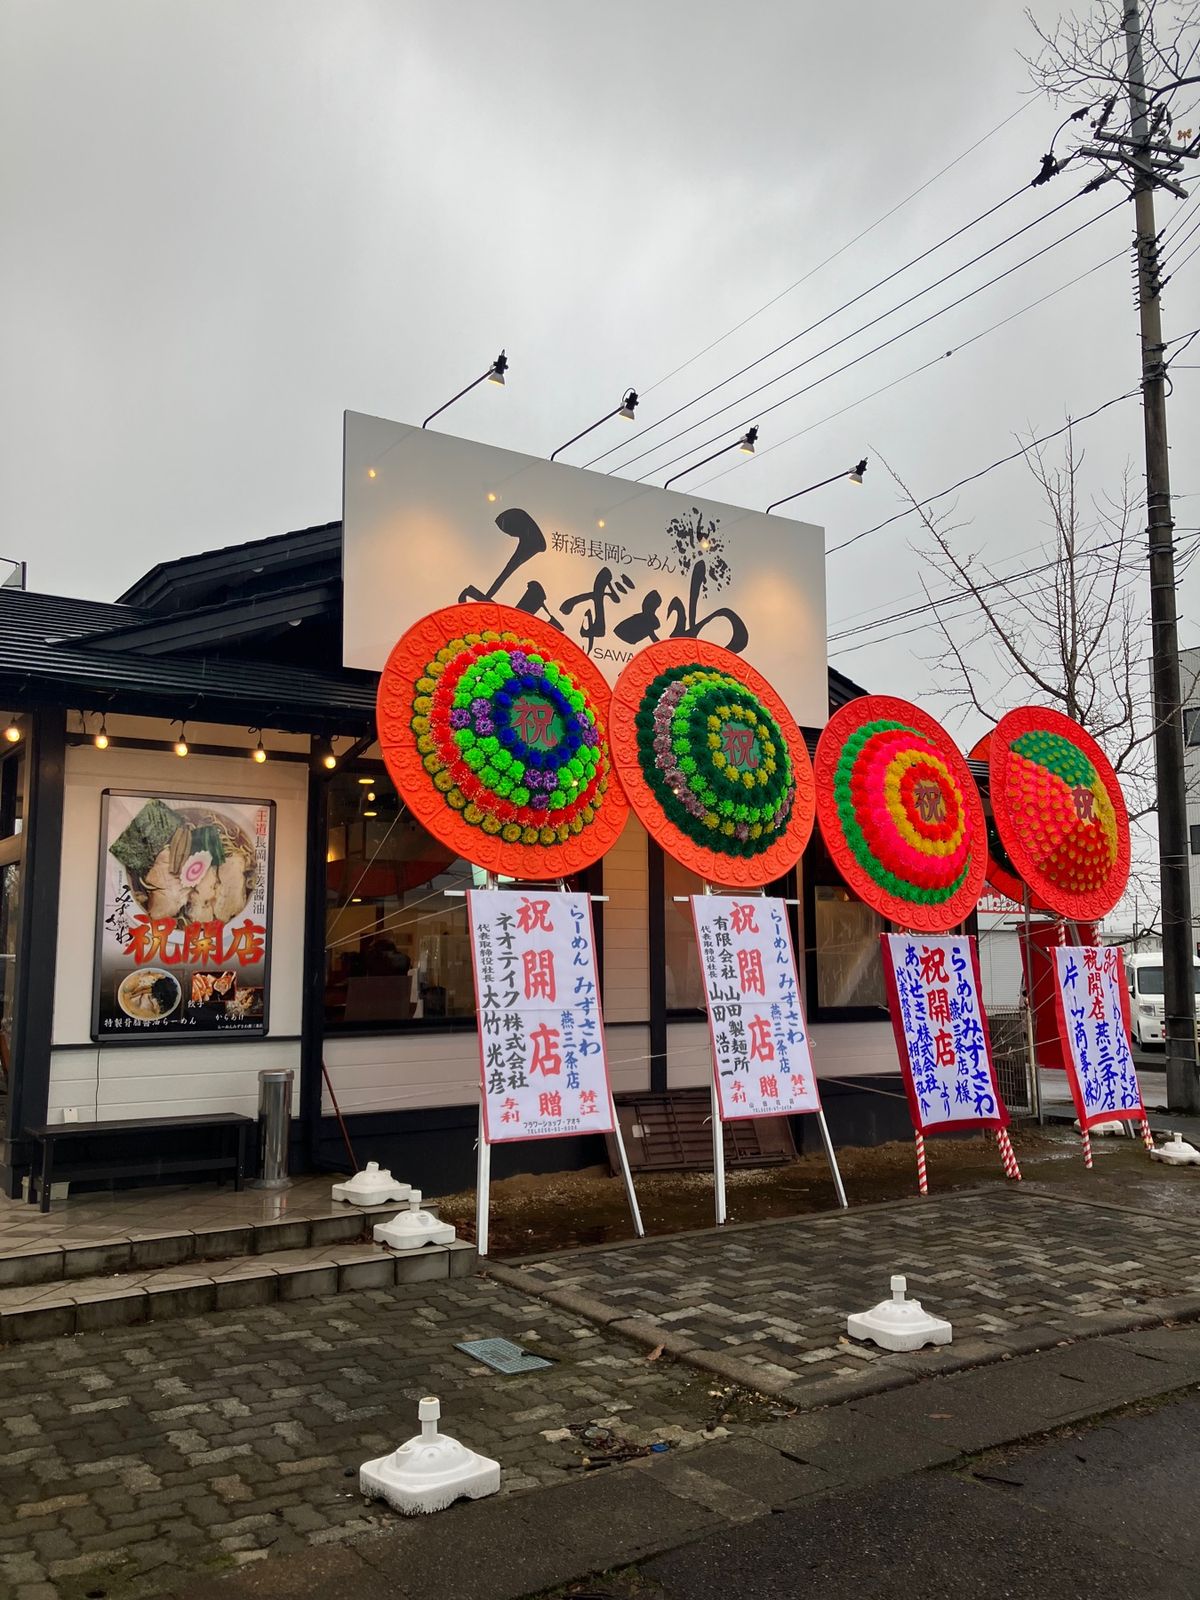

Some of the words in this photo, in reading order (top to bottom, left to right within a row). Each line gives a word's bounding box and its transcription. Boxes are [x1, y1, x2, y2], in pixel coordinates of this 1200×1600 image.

[551, 531, 676, 574] 新潟長岡らーめん
[510, 697, 558, 747] 祝
[721, 724, 758, 768] 祝
[914, 783, 946, 822] 祝
[123, 914, 267, 967] 祝開店
[477, 923, 495, 984] 代表取締役社長
[516, 896, 562, 1078] 祝開店
[729, 901, 775, 1062] 祝開店
[919, 944, 956, 1068] 祝開店
[560, 1009, 580, 1090] 燕三条店
[770, 1003, 790, 1074] 燕三条店
[1083, 948, 1106, 1020] 祝開店
[1095, 1021, 1119, 1111] 燕三条店
[538, 1090, 562, 1117] 贈
[759, 1074, 778, 1098] 贈
[939, 1080, 951, 1119] より
